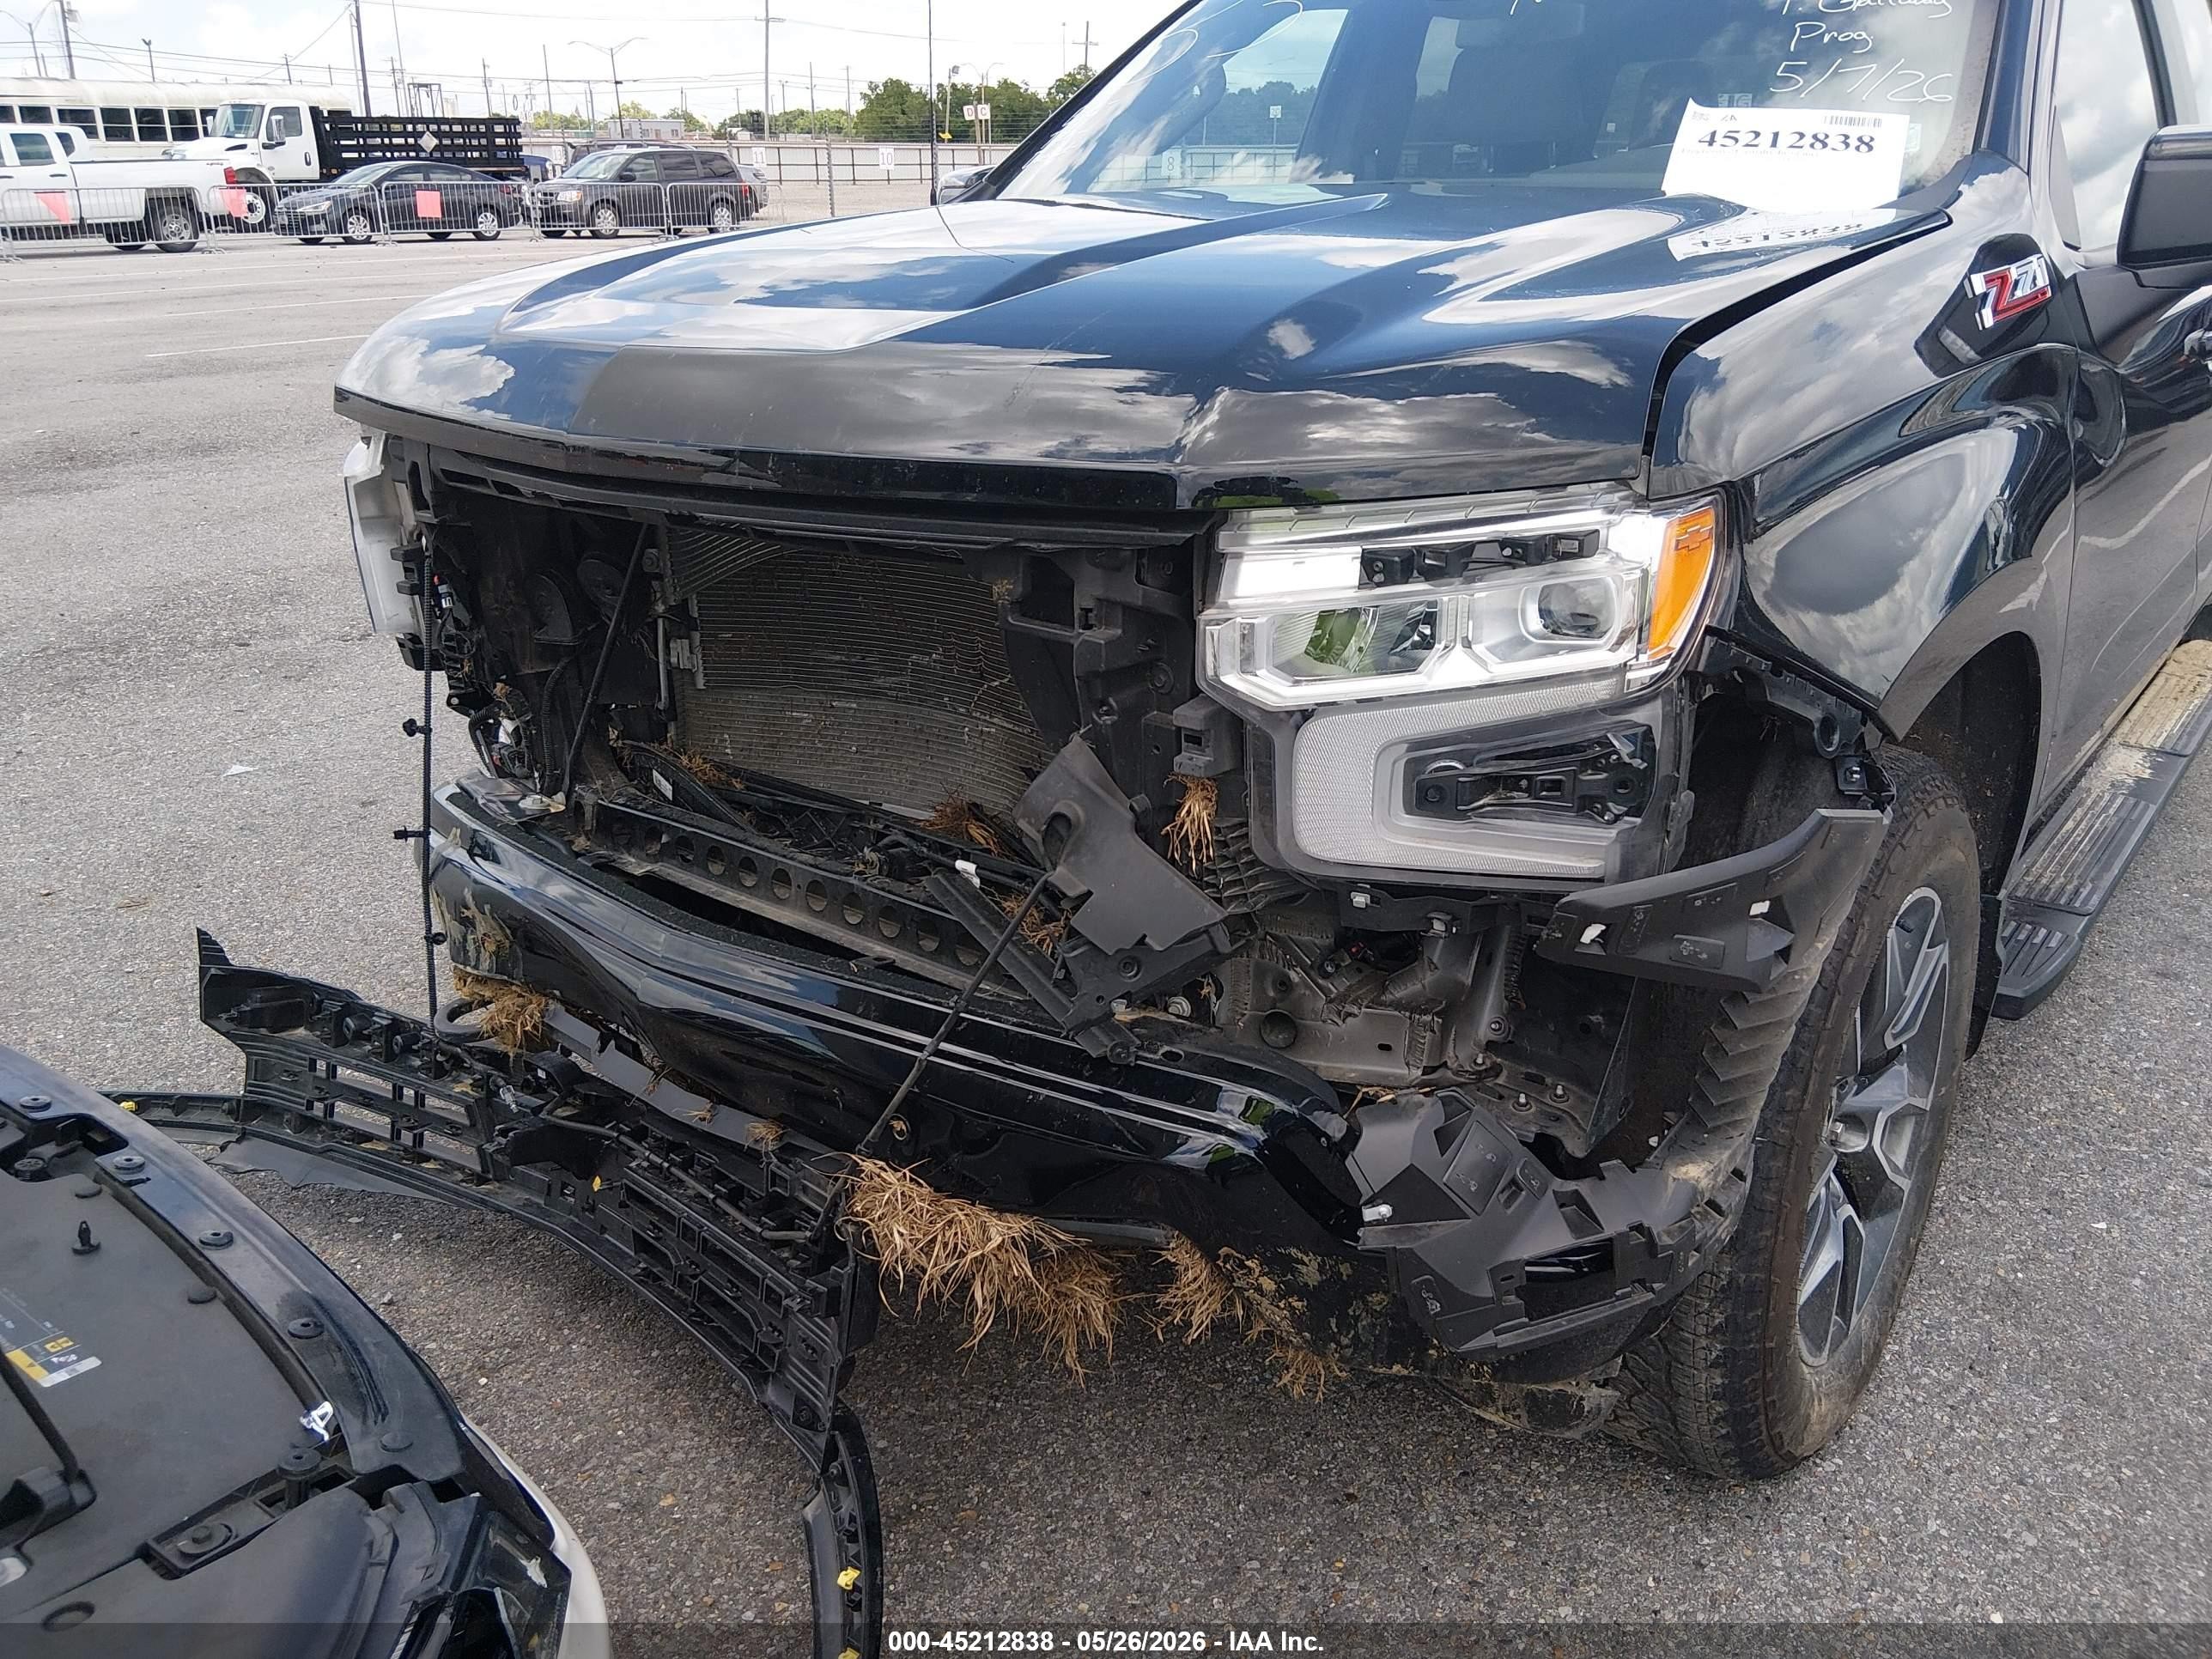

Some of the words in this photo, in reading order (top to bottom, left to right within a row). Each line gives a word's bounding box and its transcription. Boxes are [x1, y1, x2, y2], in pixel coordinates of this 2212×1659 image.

[1770, 58, 1954, 102] 5/7/26
[1698, 130, 1875, 153] 45212838
[881, 152, 892, 165] 10
[1168, 156, 1174, 171] 8
[1964, 253, 2052, 331] Z71
